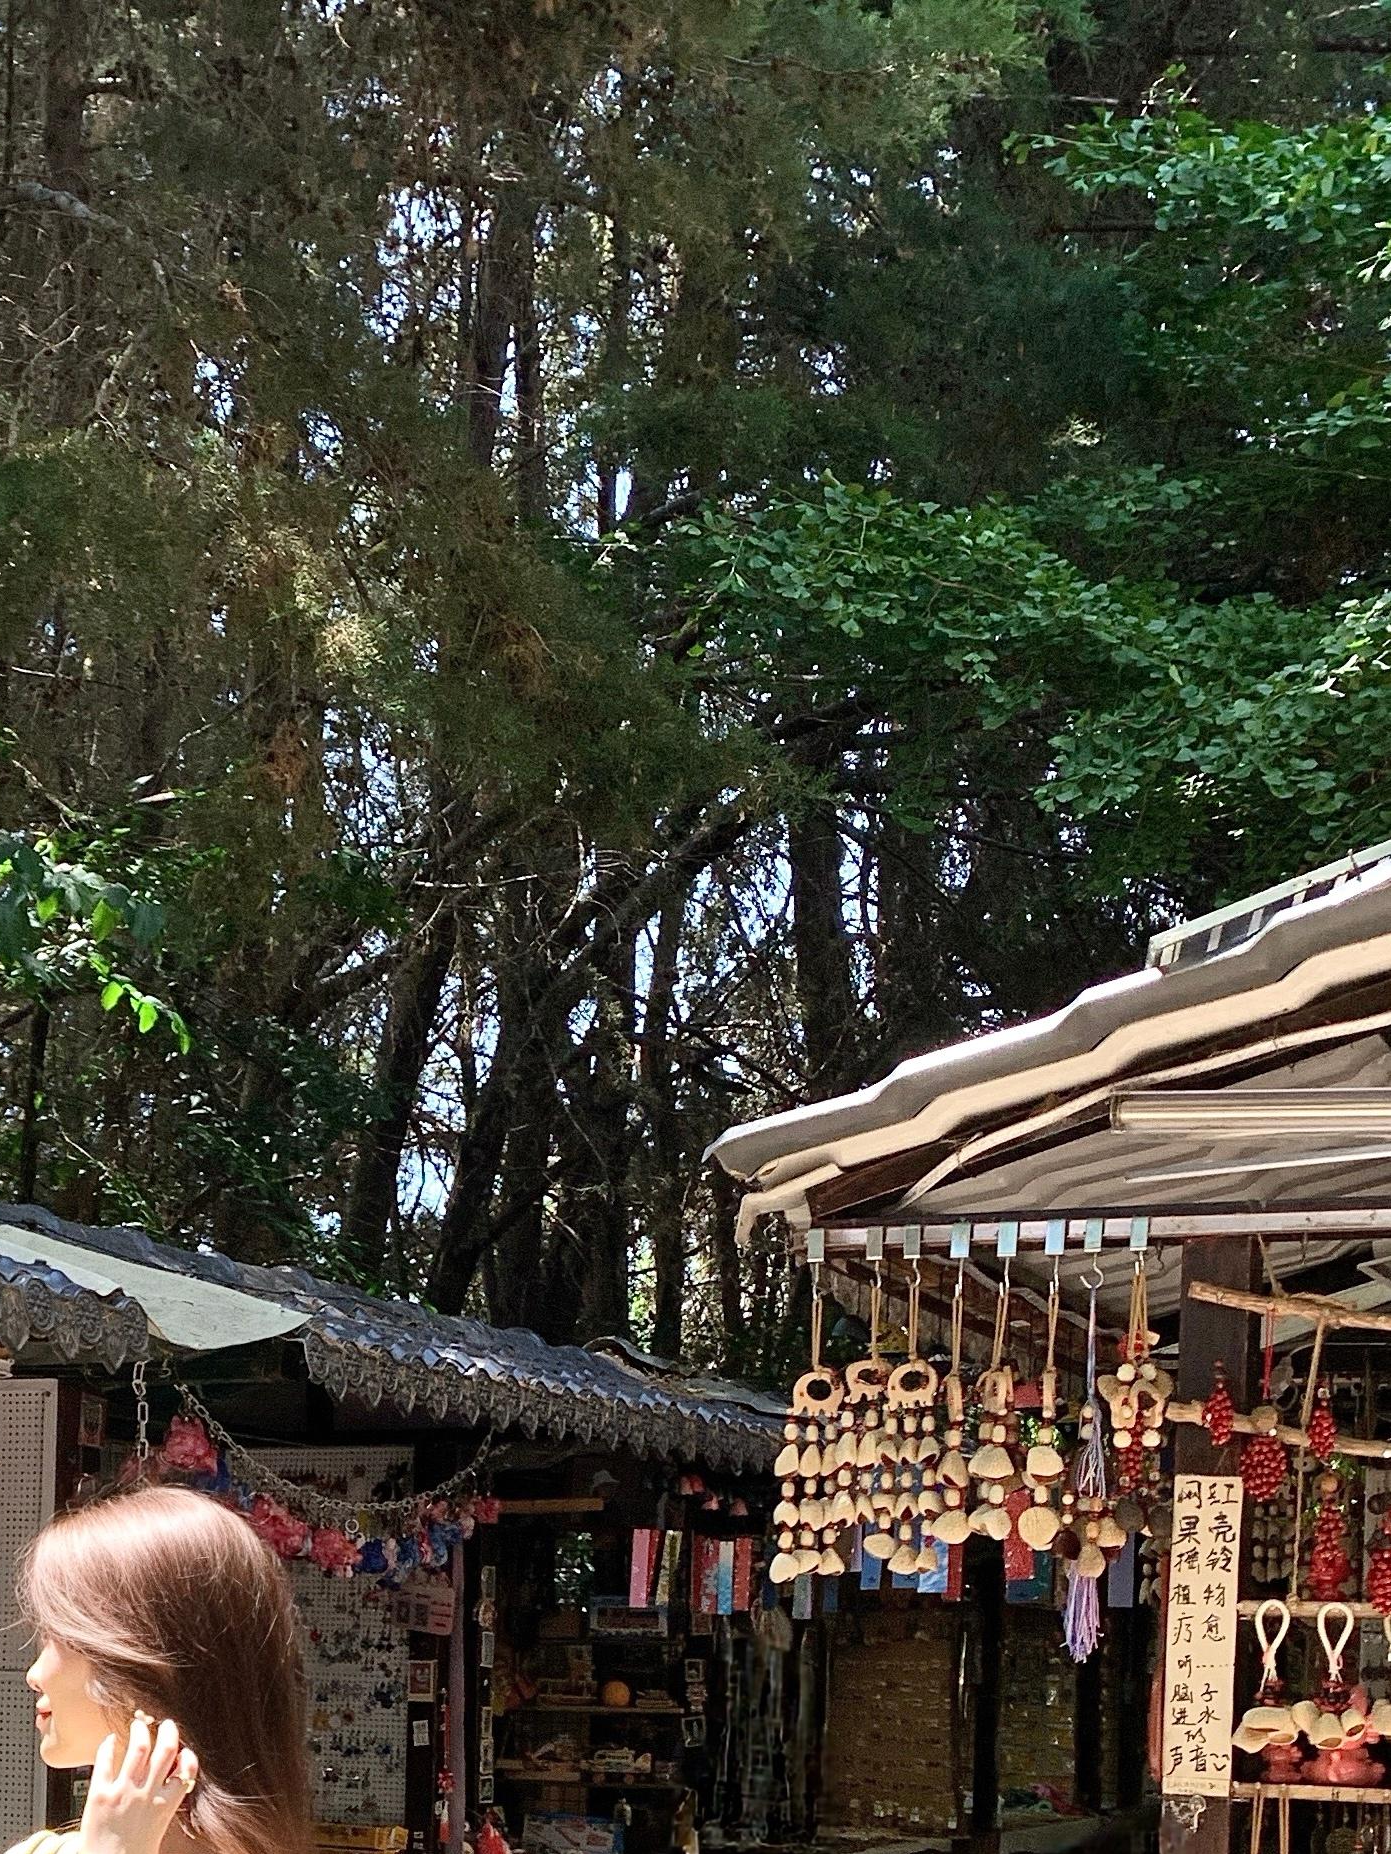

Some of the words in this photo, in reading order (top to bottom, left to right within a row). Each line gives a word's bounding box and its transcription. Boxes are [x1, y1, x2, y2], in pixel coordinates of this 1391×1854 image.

[1176, 1480, 1239, 1509] 网红
[1172, 1511, 1236, 1545] 果壳
[1169, 1582, 1226, 1608] 植物
[1171, 1612, 1226, 1646] 疗愈
[1170, 1682, 1219, 1703] 脑子
[1171, 1705, 1221, 1726] 进水
[1166, 1744, 1208, 1776] 声音
